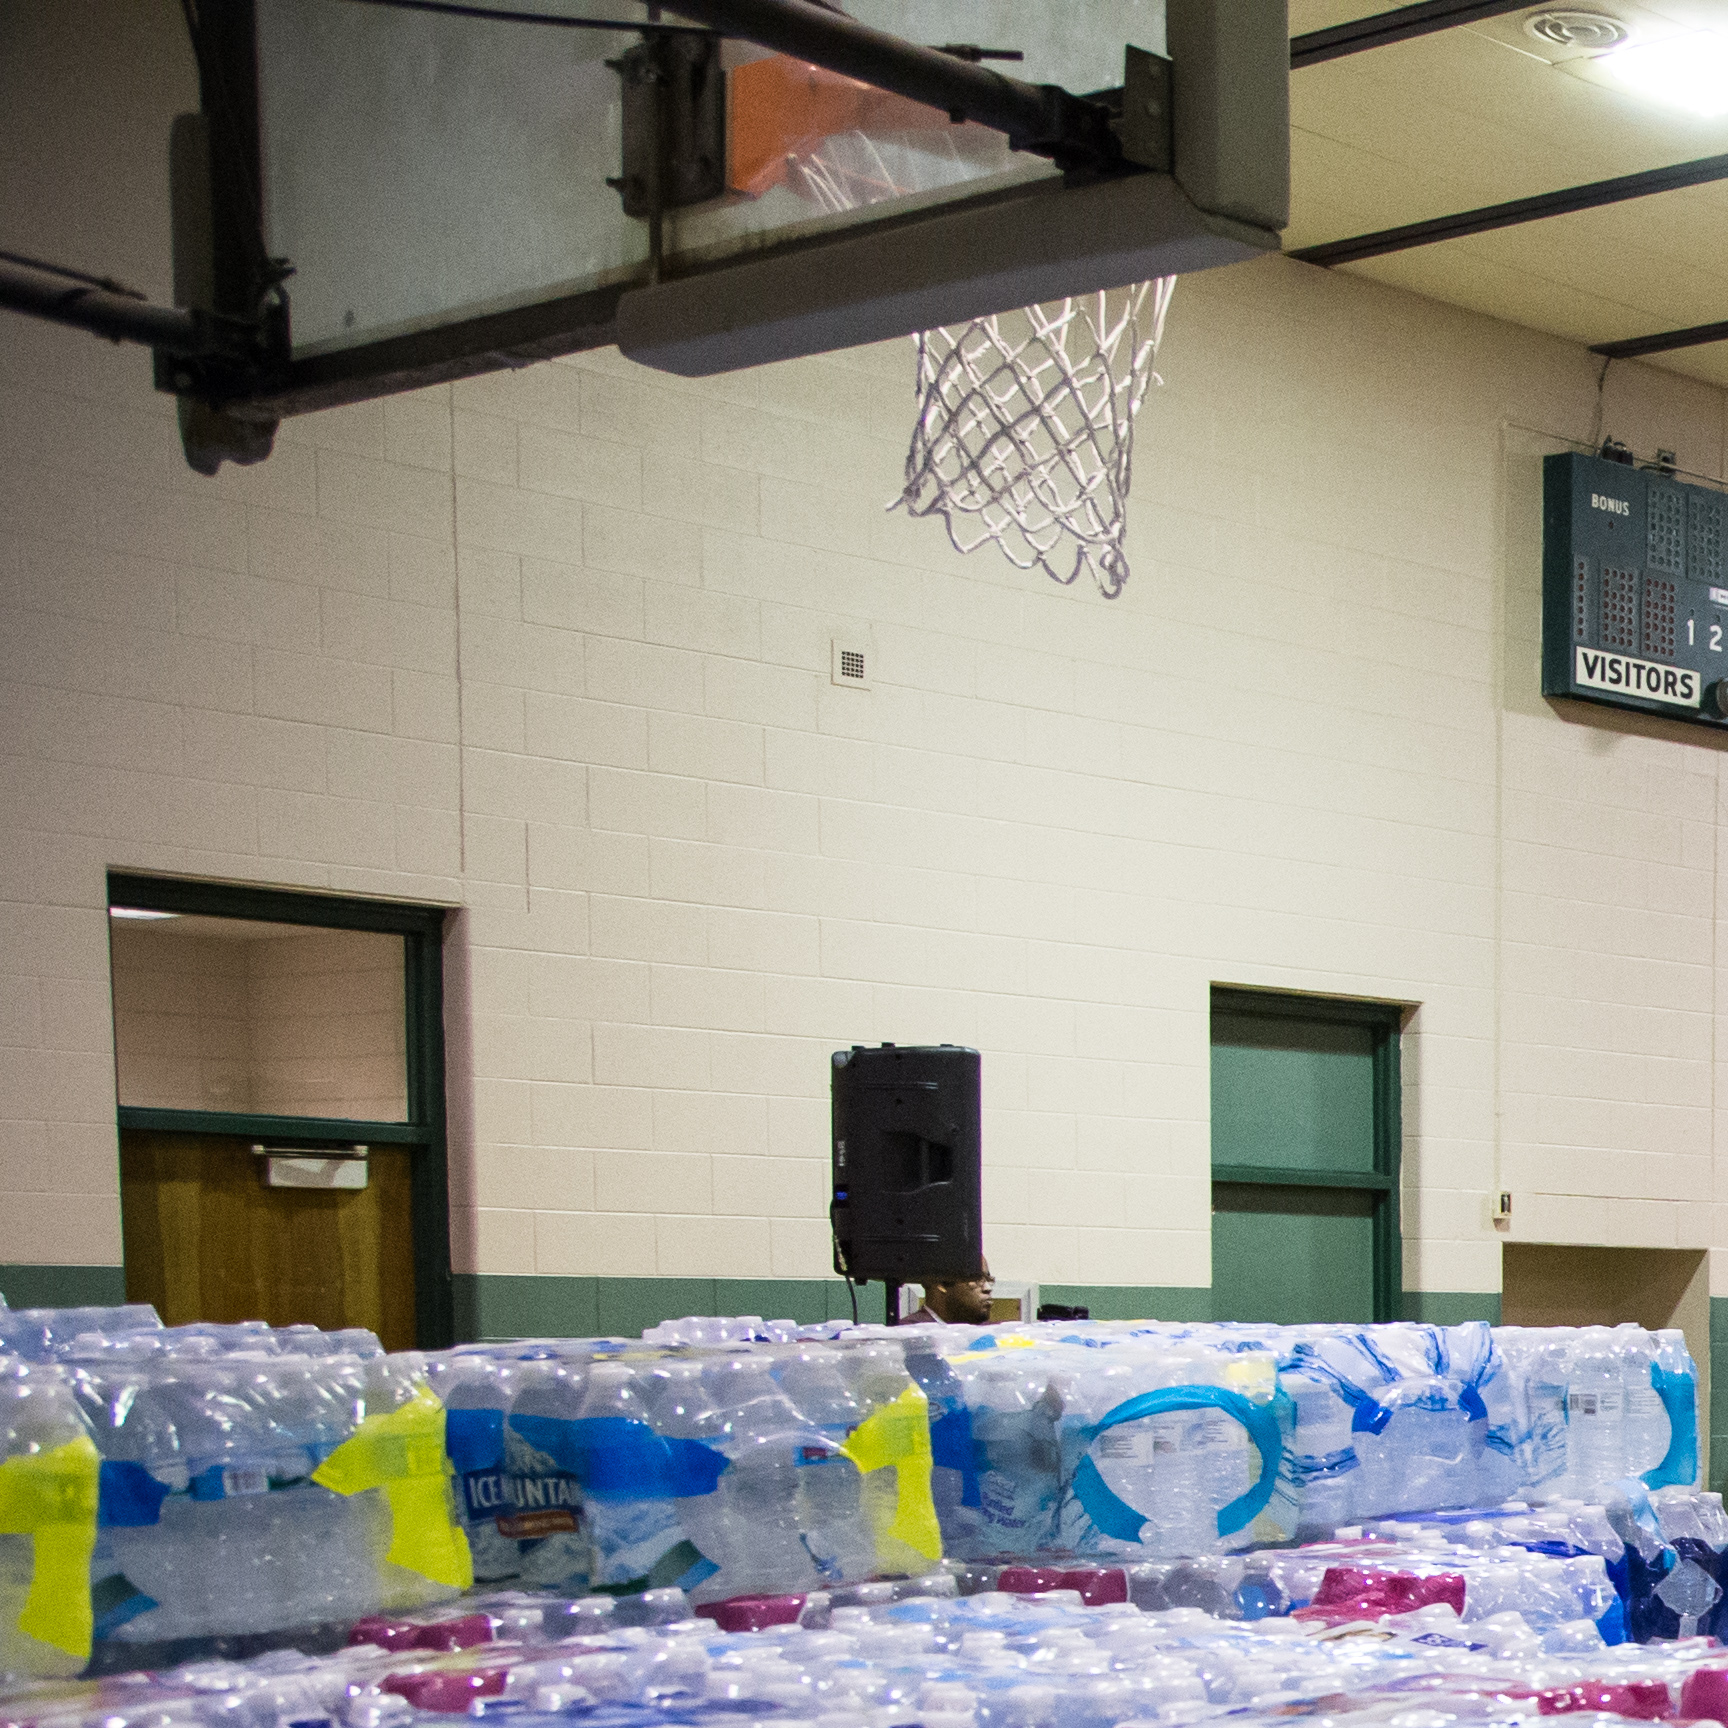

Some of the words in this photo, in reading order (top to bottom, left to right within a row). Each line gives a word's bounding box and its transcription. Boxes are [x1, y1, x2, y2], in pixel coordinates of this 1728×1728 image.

[1591, 492, 1630, 517] BONUS
[1686, 618, 1695, 646] 1
[1708, 624, 1723, 653] 2
[1581, 651, 1694, 700] VISITORS
[468, 1475, 500, 1509] ICE
